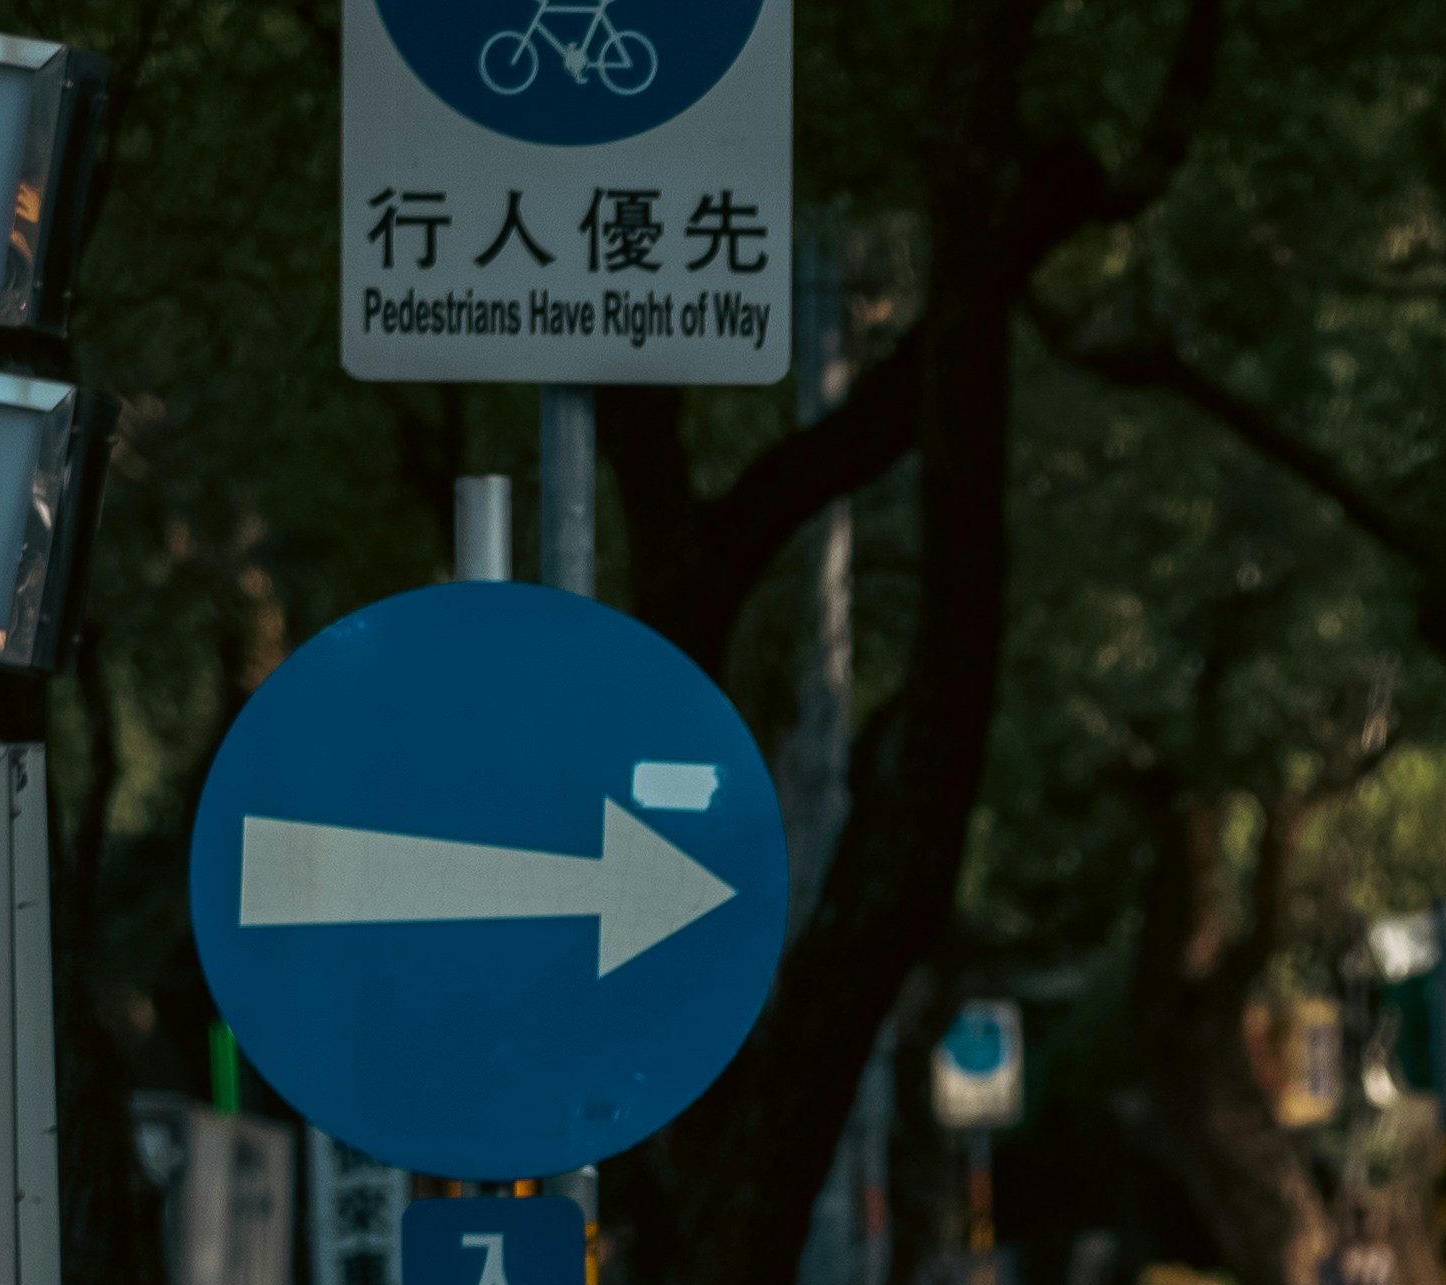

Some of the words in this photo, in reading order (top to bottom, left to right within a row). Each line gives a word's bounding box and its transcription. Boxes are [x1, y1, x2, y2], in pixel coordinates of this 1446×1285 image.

[366, 186, 771, 274] 行人優先
[363, 288, 521, 336] Pedestrians
[529, 289, 595, 337] Have
[603, 290, 674, 348] Right
[681, 292, 709, 338] of
[712, 292, 771, 349] Way
